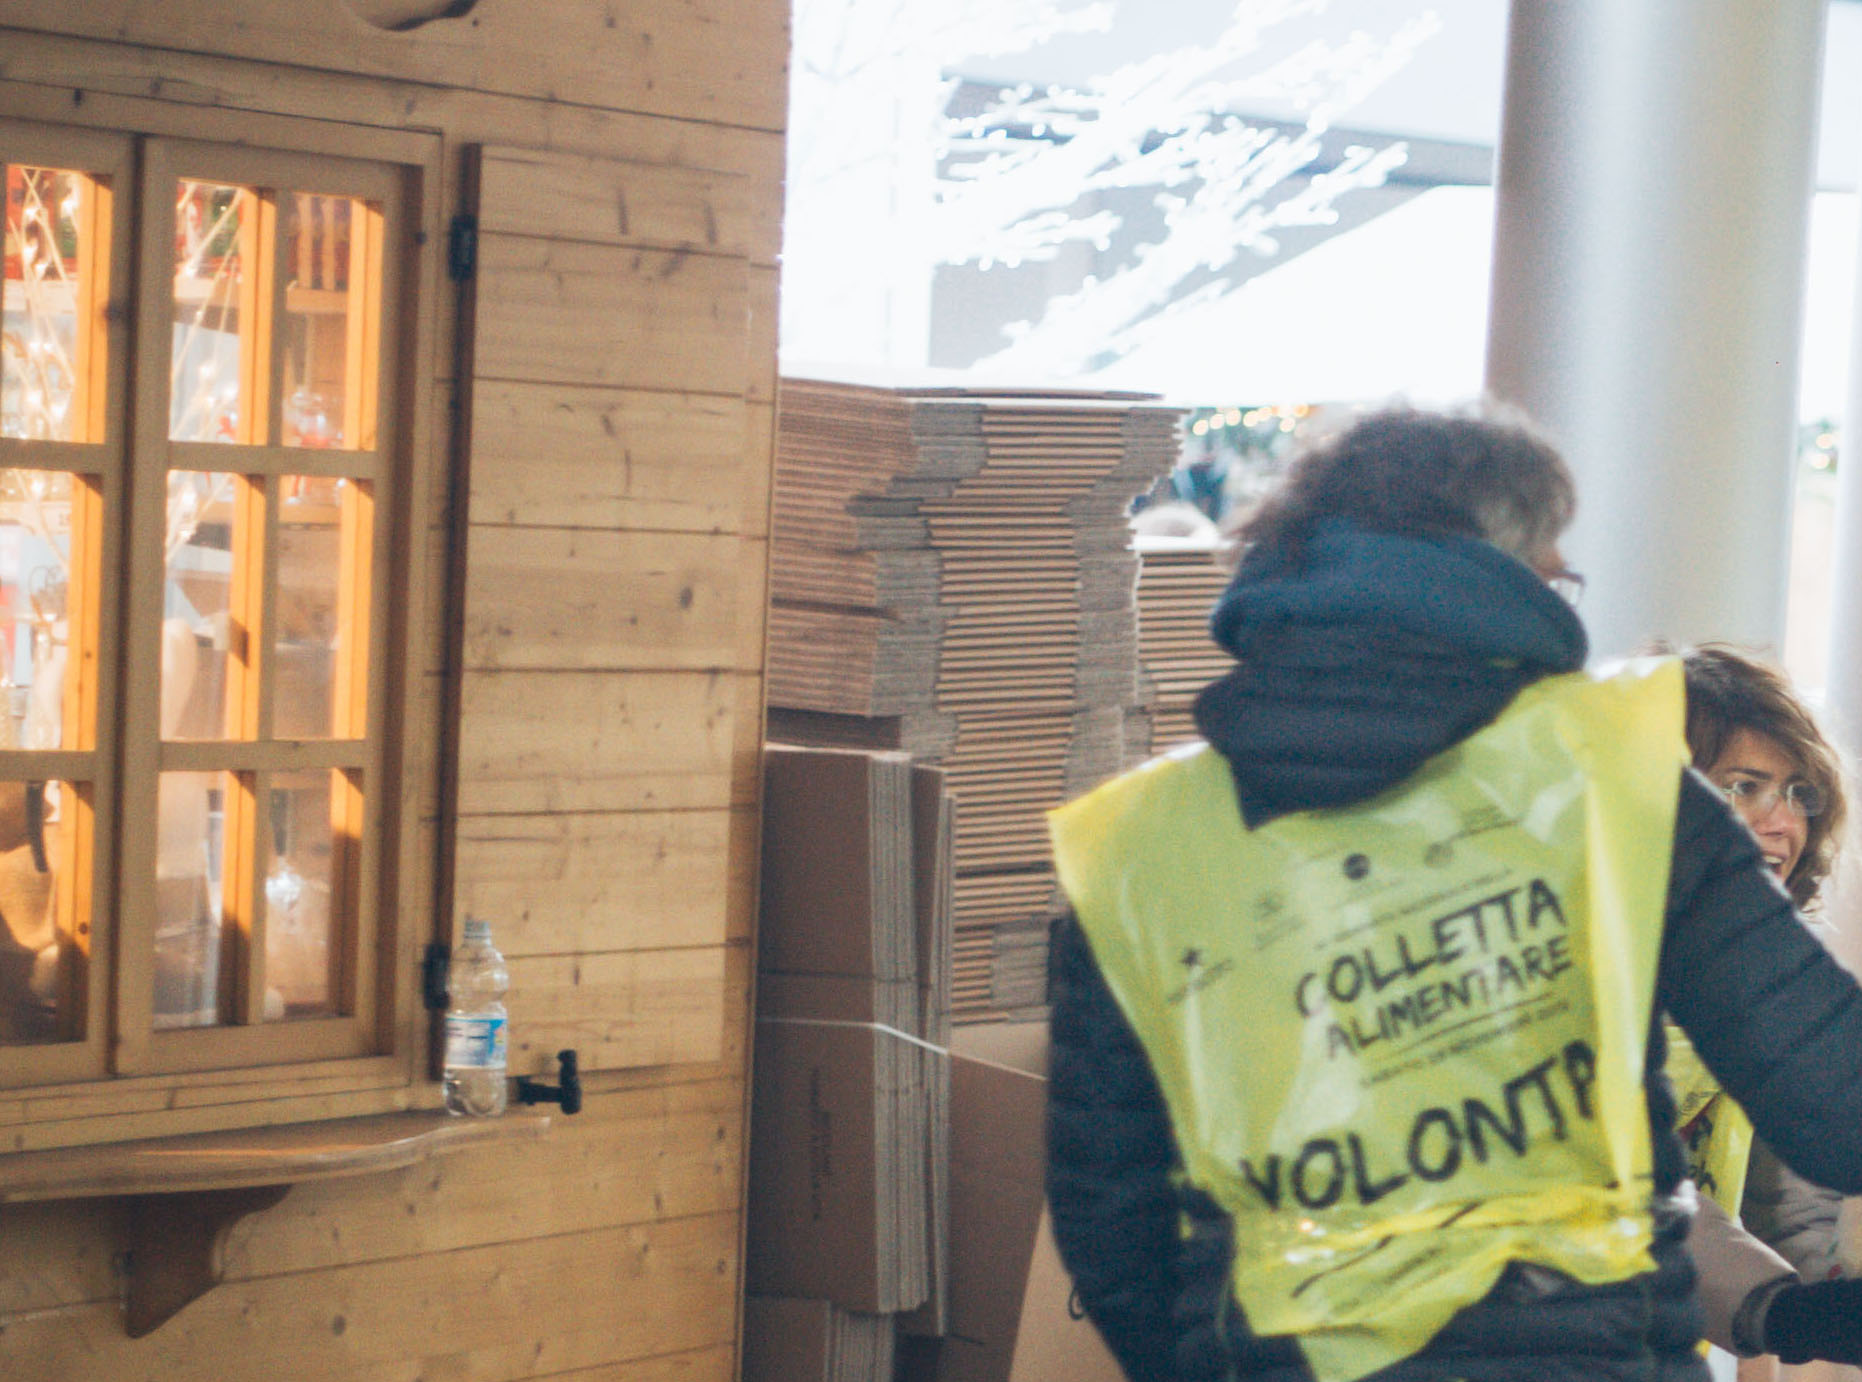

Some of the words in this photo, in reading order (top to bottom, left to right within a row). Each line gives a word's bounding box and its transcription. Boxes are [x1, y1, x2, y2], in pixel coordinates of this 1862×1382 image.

[1294, 876, 1568, 1019] COLLETTA
[1325, 933, 1574, 1061] ALIMENTARE
[1238, 1038, 1598, 1213] VOLONTA
